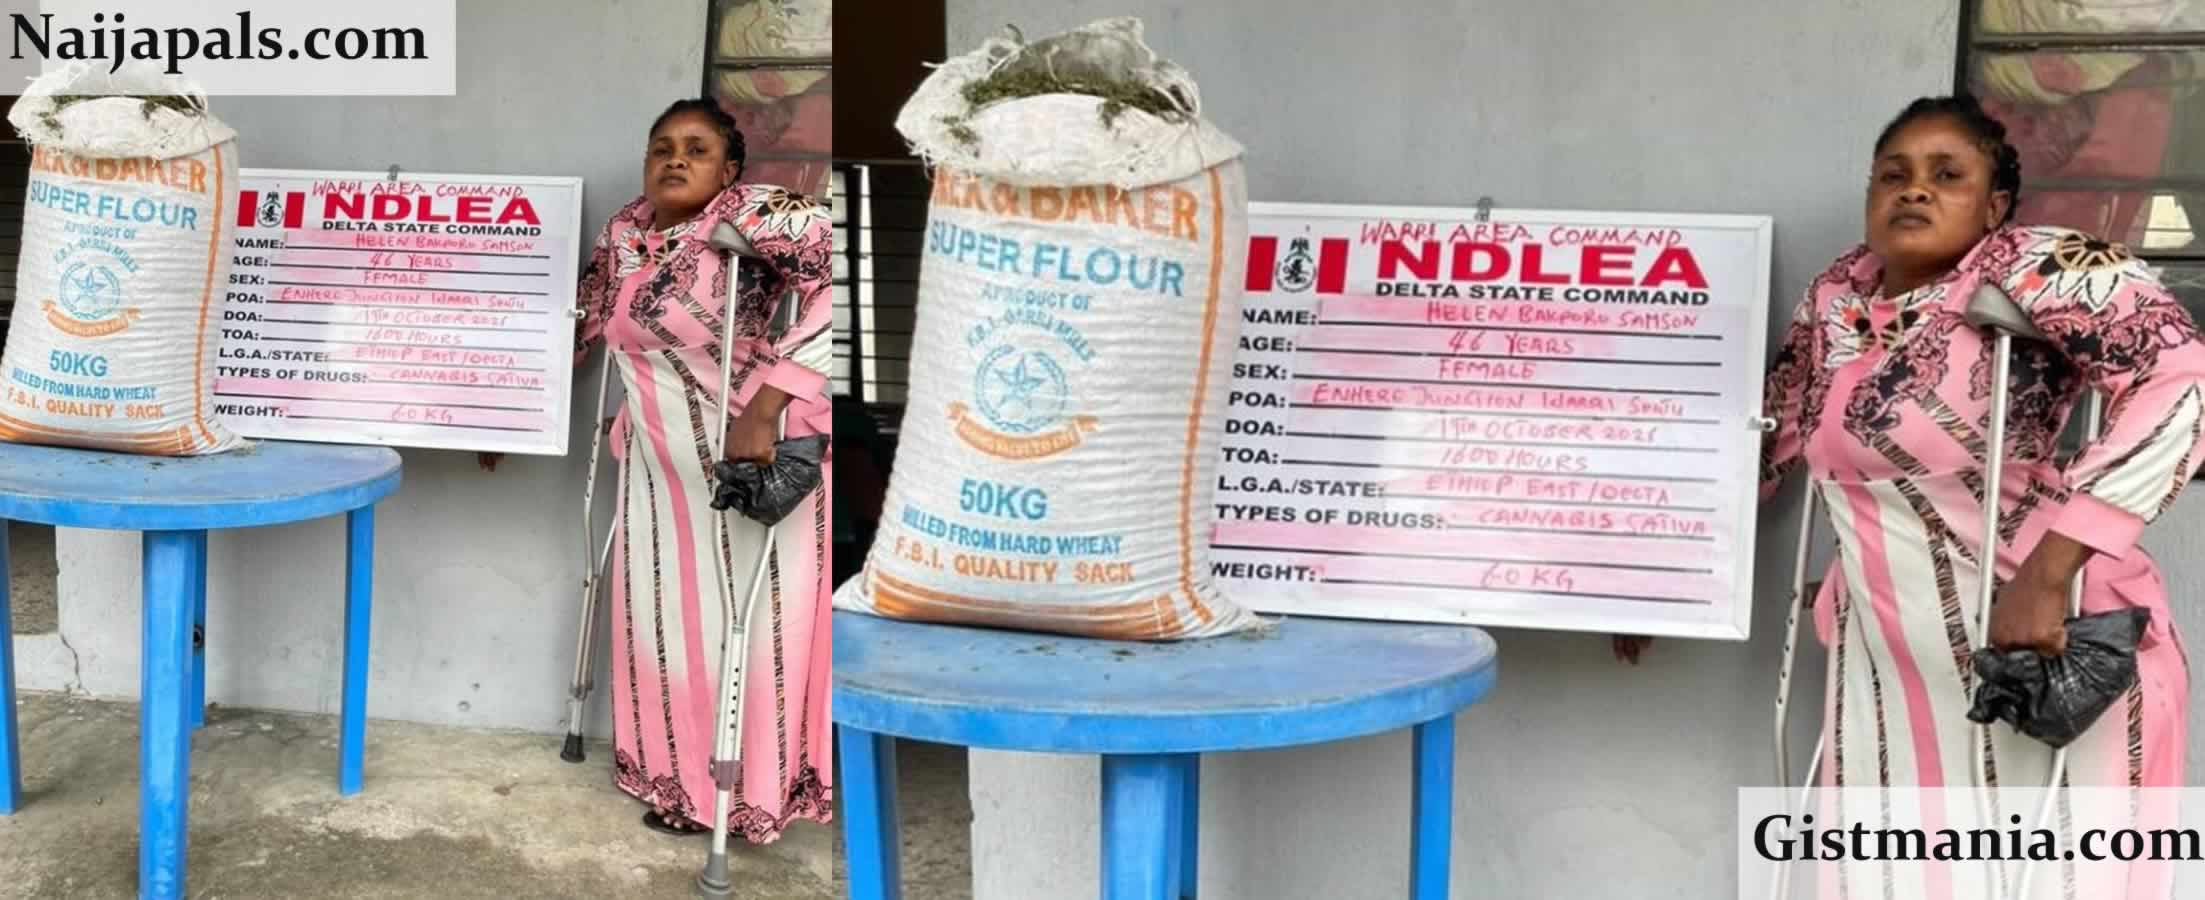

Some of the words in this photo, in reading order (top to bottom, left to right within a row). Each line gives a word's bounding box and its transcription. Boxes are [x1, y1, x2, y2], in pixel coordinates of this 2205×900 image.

[96, 157, 207, 193] BAKER
[370, 181, 426, 196] AREA
[436, 184, 524, 198] COMMAND
[31, 180, 90, 216] SUPER
[98, 193, 198, 230] FLOUR
[323, 193, 542, 226] NDLEA
[1029, 181, 1199, 241] BAKER
[323, 221, 378, 232] DELTA
[384, 222, 440, 234] STATE
[445, 224, 542, 237] COMMAND
[1448, 221, 1534, 245] AREA
[1550, 226, 1683, 247] COMMAND
[235, 239, 284, 250] NAME:
[356, 233, 411, 248] HELEN
[232, 256, 268, 267] AGE:
[370, 252, 395, 267] 46
[408, 254, 454, 269] YEARS
[929, 219, 1022, 274] SUPER
[1031, 241, 1186, 297] FLOUR
[1376, 240, 1710, 289] NDLEA
[229, 274, 264, 285] SEX:
[363, 271, 429, 285] FEMALE
[226, 292, 263, 304] POA:
[1375, 282, 1459, 298] DELTA
[1468, 284, 1554, 301] STATE
[1563, 287, 1710, 306] COMMAND
[224, 311, 262, 322] DOA:
[1241, 308, 1317, 326] NAME:
[1426, 301, 1510, 324] HELEN
[1618, 310, 1699, 330] SAMSON
[222, 329, 259, 341] TOA:
[1238, 335, 1293, 352] AGE:
[1448, 329, 1486, 354] 46
[1504, 331, 1576, 357] YEARS
[50, 350, 108, 378] 50KG
[219, 347, 328, 362] L.G.A./STATE:
[217, 366, 270, 379] TYPES
[276, 368, 299, 380] OF
[304, 370, 368, 384] DRUGS:
[390, 368, 480, 384] CANNABIS
[1233, 362, 1287, 380] SEX:
[1438, 357, 1537, 381] FEMALE
[43, 379, 74, 397] FROM
[76, 384, 111, 400] HARD
[113, 386, 157, 400] WHEAT
[1228, 391, 1286, 408] POA:
[47, 399, 114, 417] QUALITY
[125, 403, 164, 419] SACK
[214, 404, 283, 418] WEIGHT:
[424, 407, 454, 424] KG
[1225, 418, 1285, 436] DOA:
[1221, 446, 1279, 465] TOA:
[1505, 446, 1588, 473] HOURS
[1218, 474, 1385, 498] L.G.A./STATE:
[1526, 477, 1581, 498] EAST
[959, 477, 1048, 520] 50KG
[1215, 503, 1297, 522] TYPES
[1305, 506, 1339, 525] OF
[1347, 510, 1445, 530] DRUGS:
[1478, 507, 1614, 528] CANNABIS
[903, 502, 947, 537] MILLED
[950, 522, 997, 551] FROM
[1000, 531, 1051, 556] HARD
[1056, 535, 1123, 555] WHEAT
[954, 553, 1058, 583] QUALITY
[1073, 560, 1137, 584] SACK
[1210, 561, 1317, 583] WEIGHT:
[1532, 567, 1575, 593] KG
